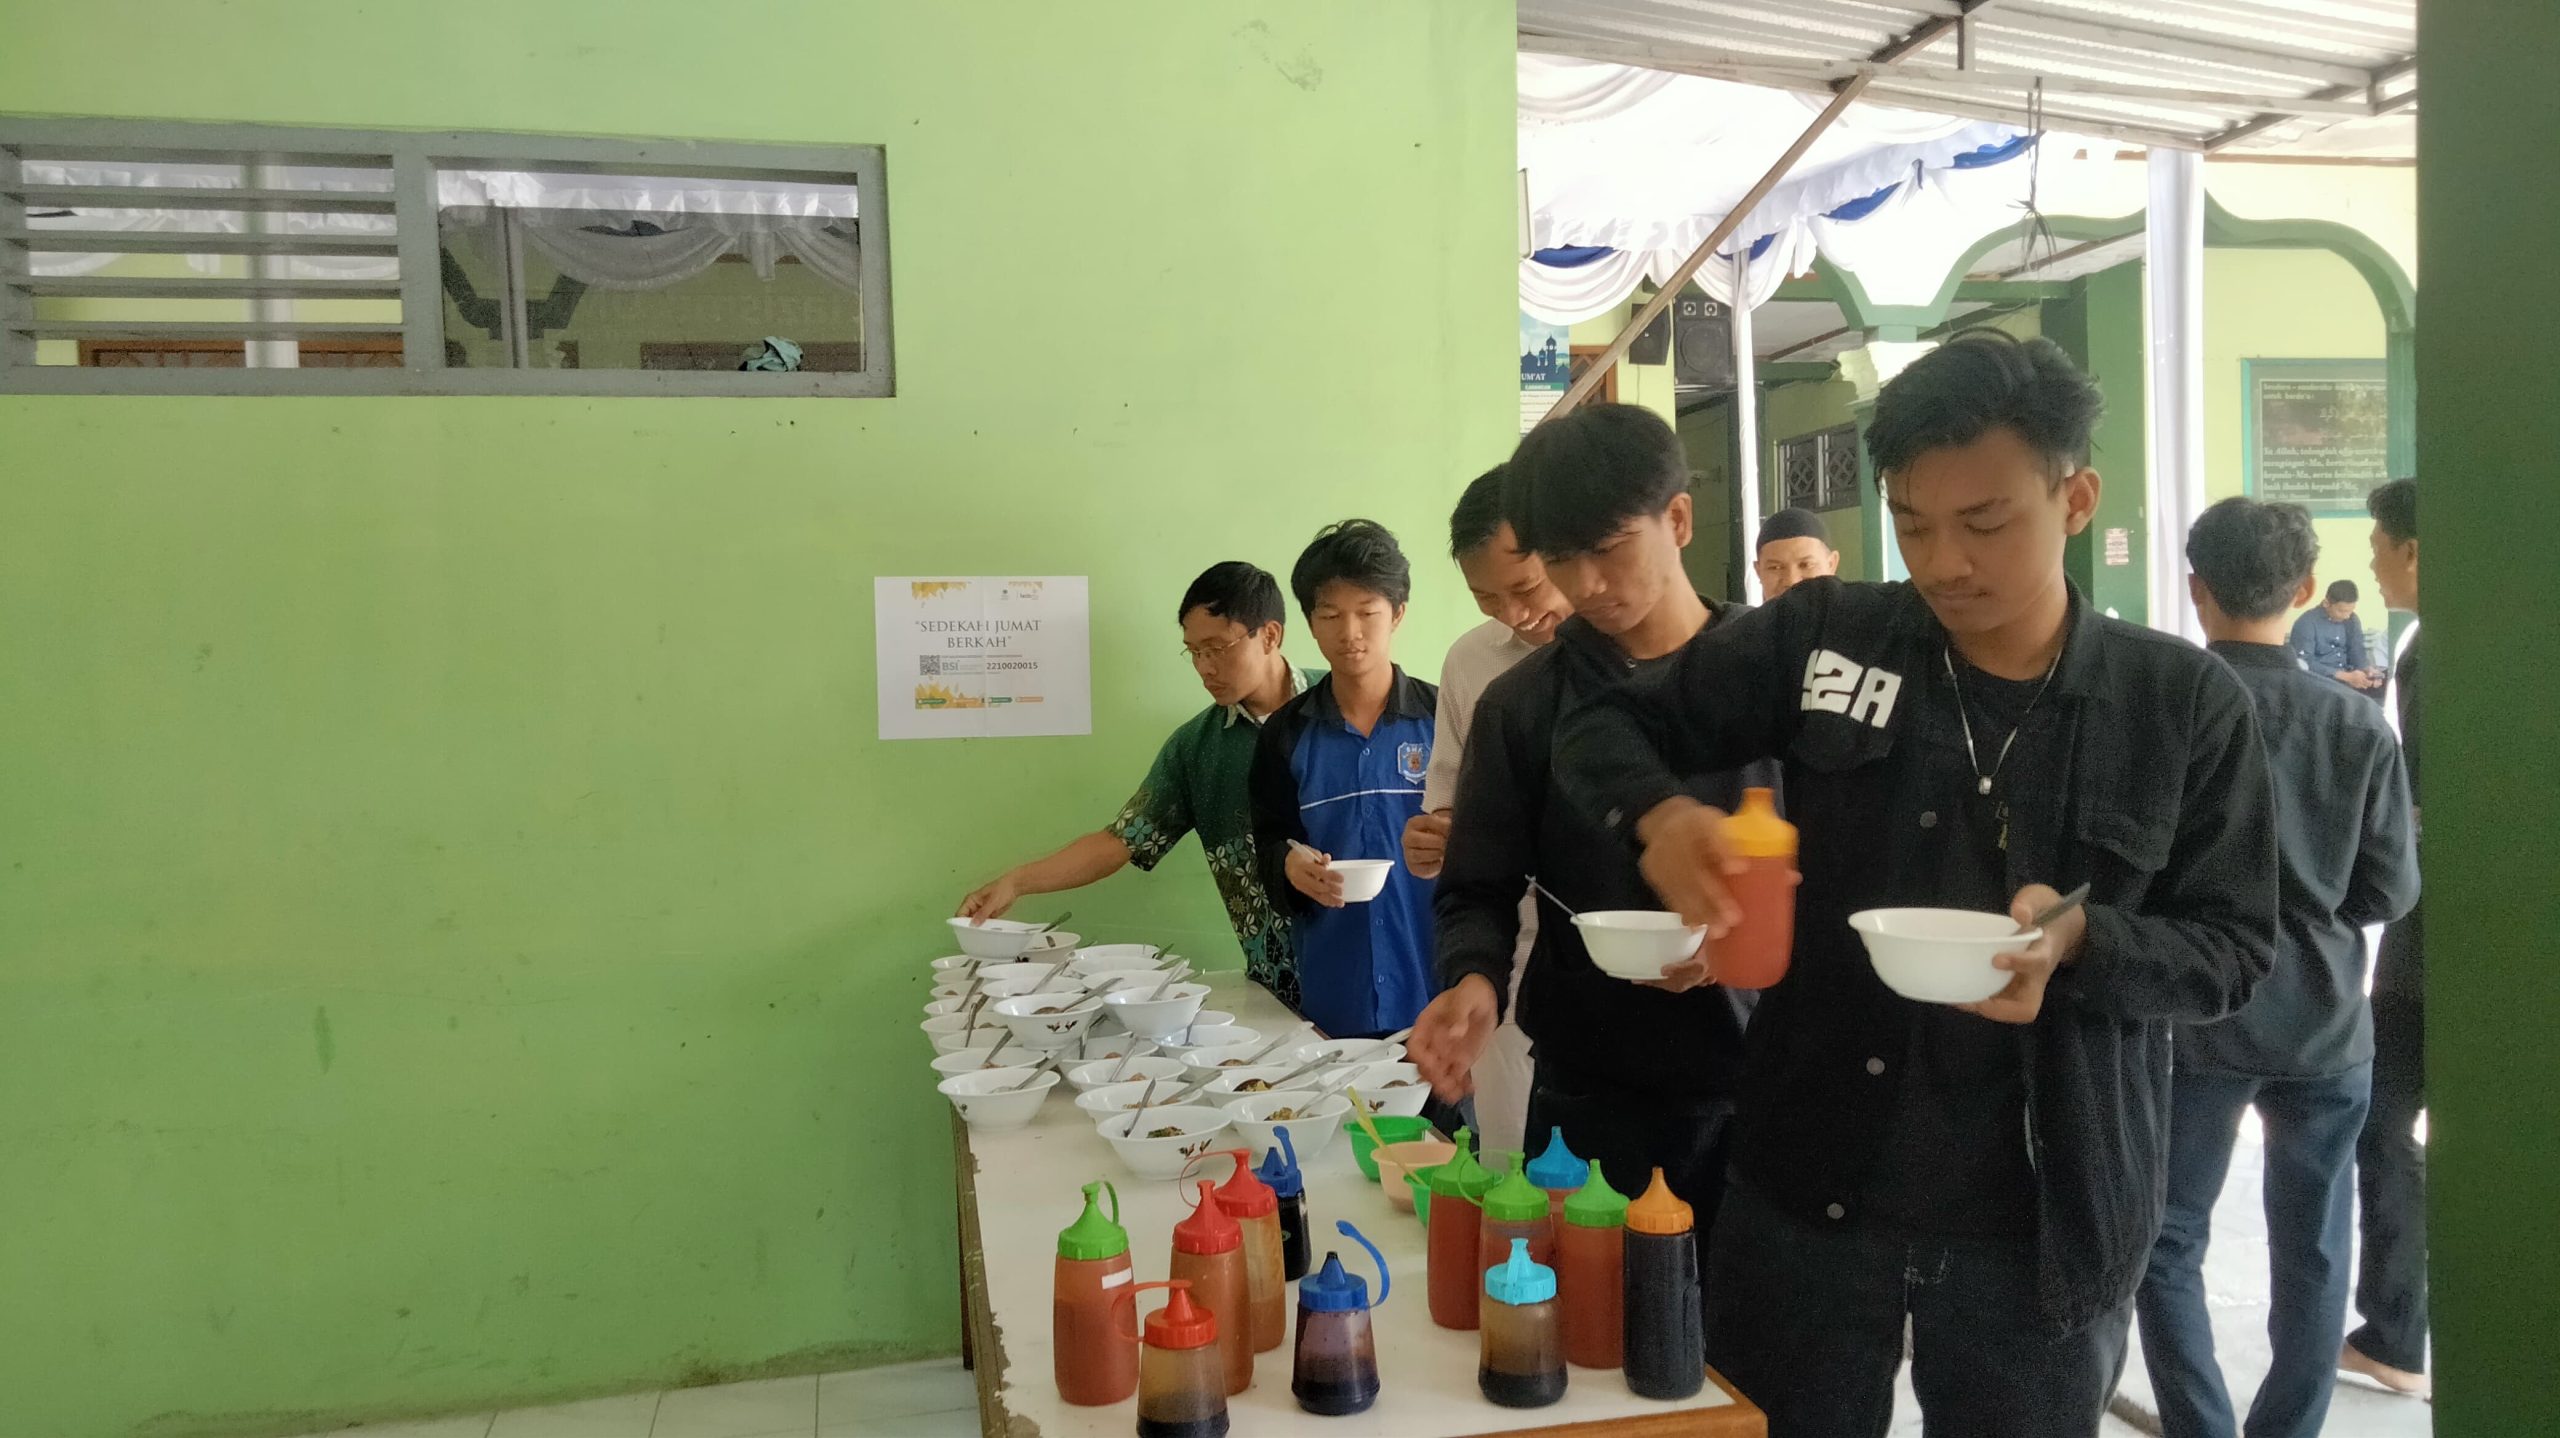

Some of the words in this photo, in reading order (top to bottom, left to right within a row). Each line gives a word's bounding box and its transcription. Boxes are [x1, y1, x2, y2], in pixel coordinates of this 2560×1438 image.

[1521, 373, 1546, 381] UM'AT
[995, 619, 1042, 634] JUMAT
[986, 661, 1038, 671] 2210020015
[1800, 649, 1902, 729] 2A
